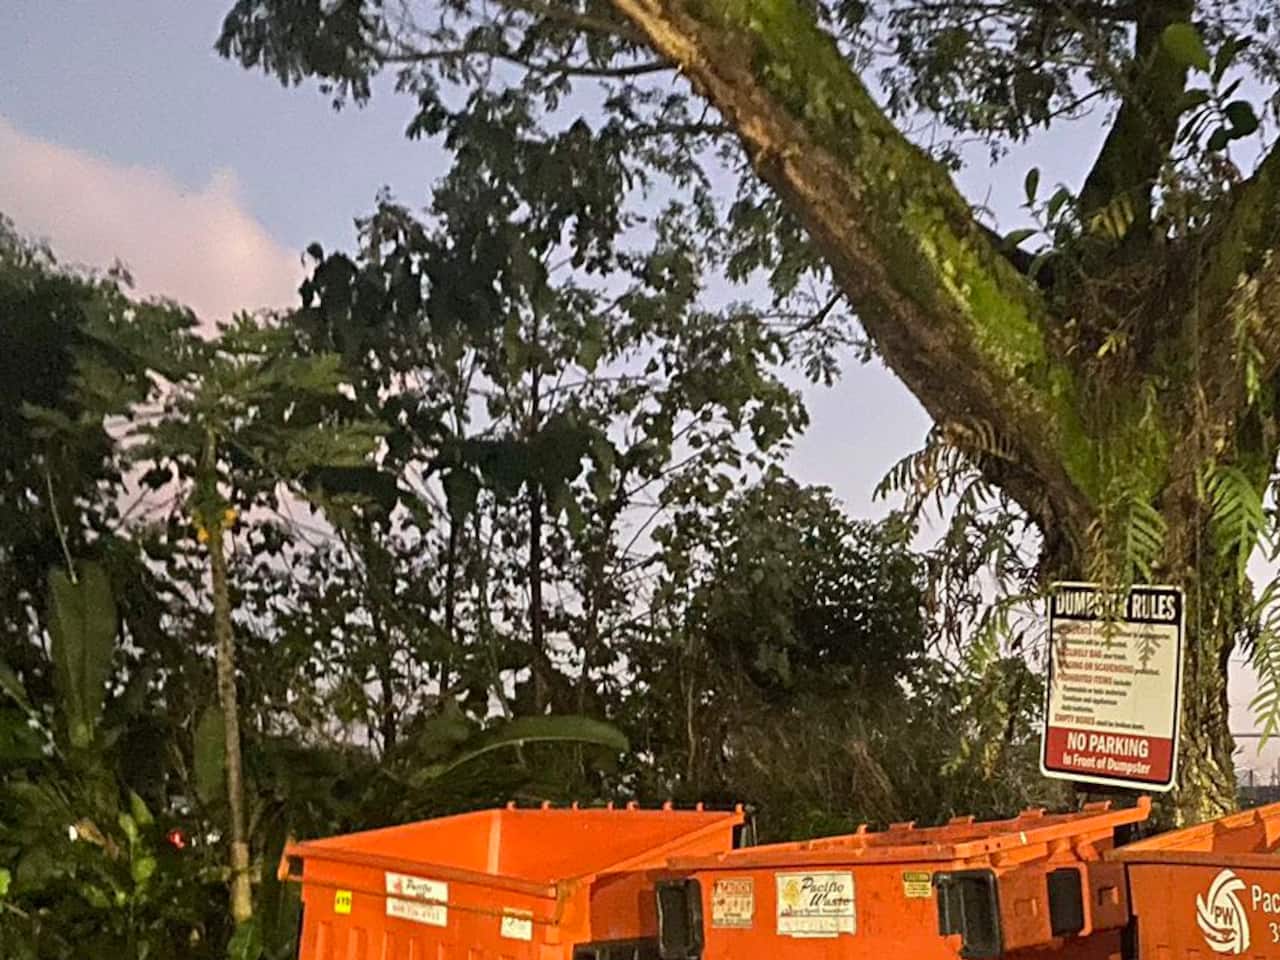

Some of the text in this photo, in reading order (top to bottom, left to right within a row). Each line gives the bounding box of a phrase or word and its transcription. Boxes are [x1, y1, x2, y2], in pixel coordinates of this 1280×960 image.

[1131, 594, 1176, 620] RULES
[1067, 732, 1149, 758] NO PARKING
[1062, 752, 1072, 765] In
[1073, 754, 1097, 768] Front
[1107, 758, 1151, 775] Dumpster
